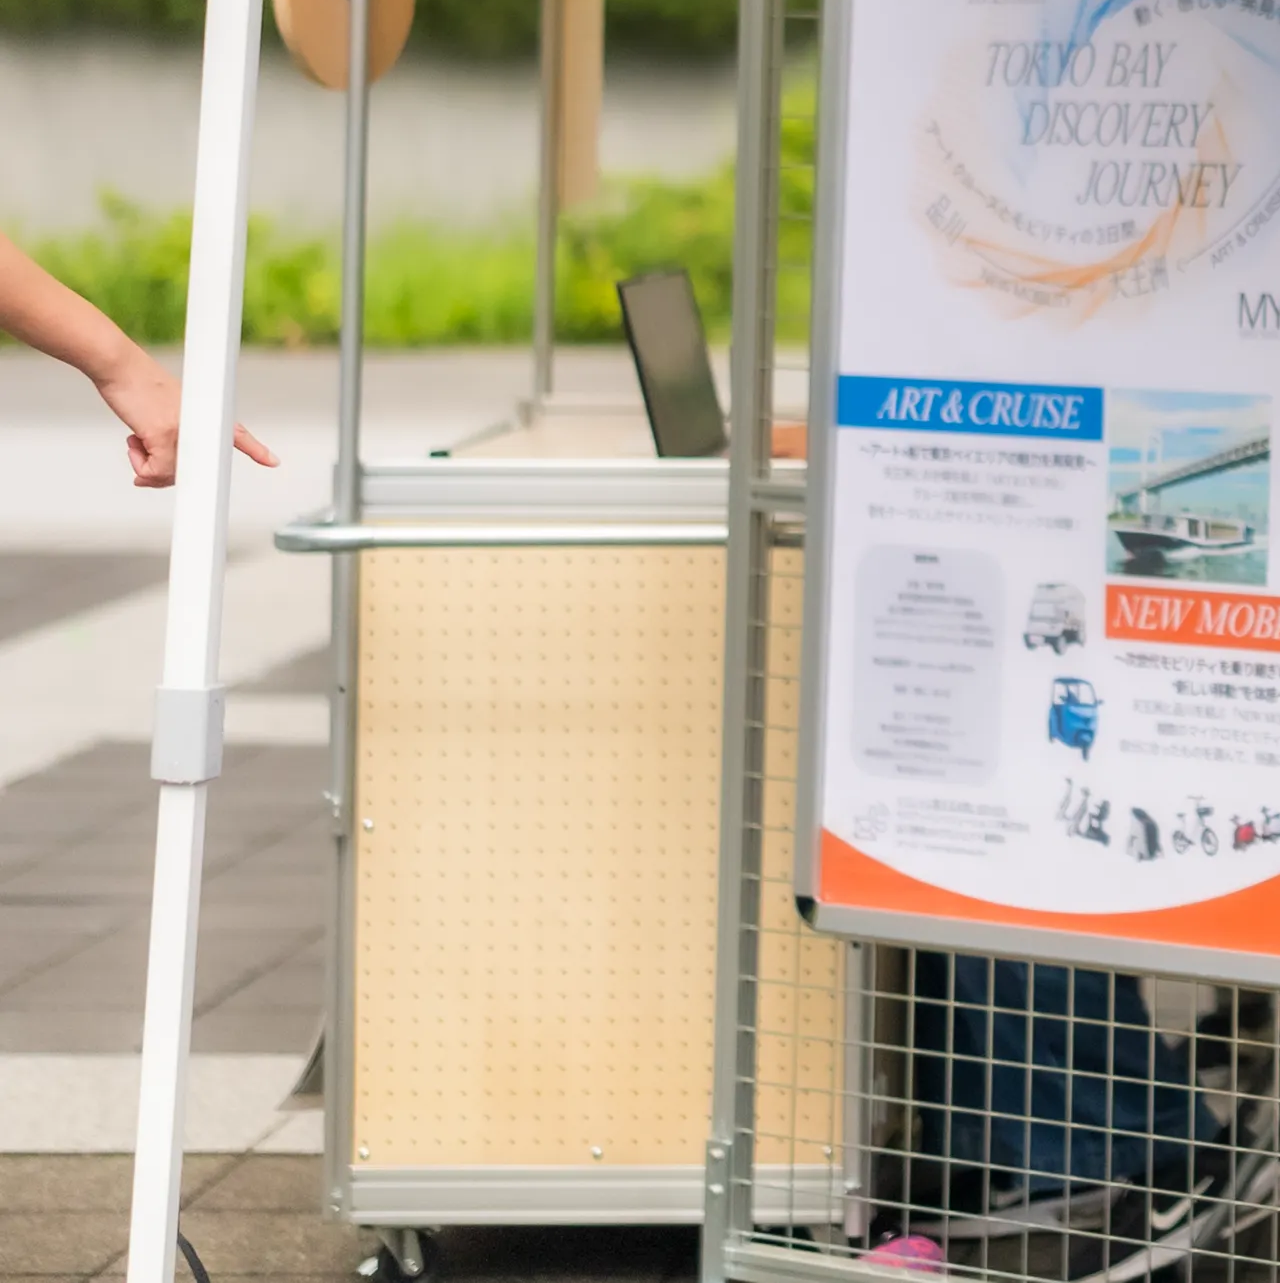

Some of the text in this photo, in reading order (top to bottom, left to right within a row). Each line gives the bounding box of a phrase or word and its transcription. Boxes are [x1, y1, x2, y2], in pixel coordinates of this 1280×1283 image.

[985, 40, 1178, 88] TOKYO BAY
[1019, 101, 1215, 148] DISCOVERY
[1075, 161, 1244, 208] JOURNEY
[877, 387, 1083, 429] ART & CRUISE
[1113, 594, 1194, 632] NEW
